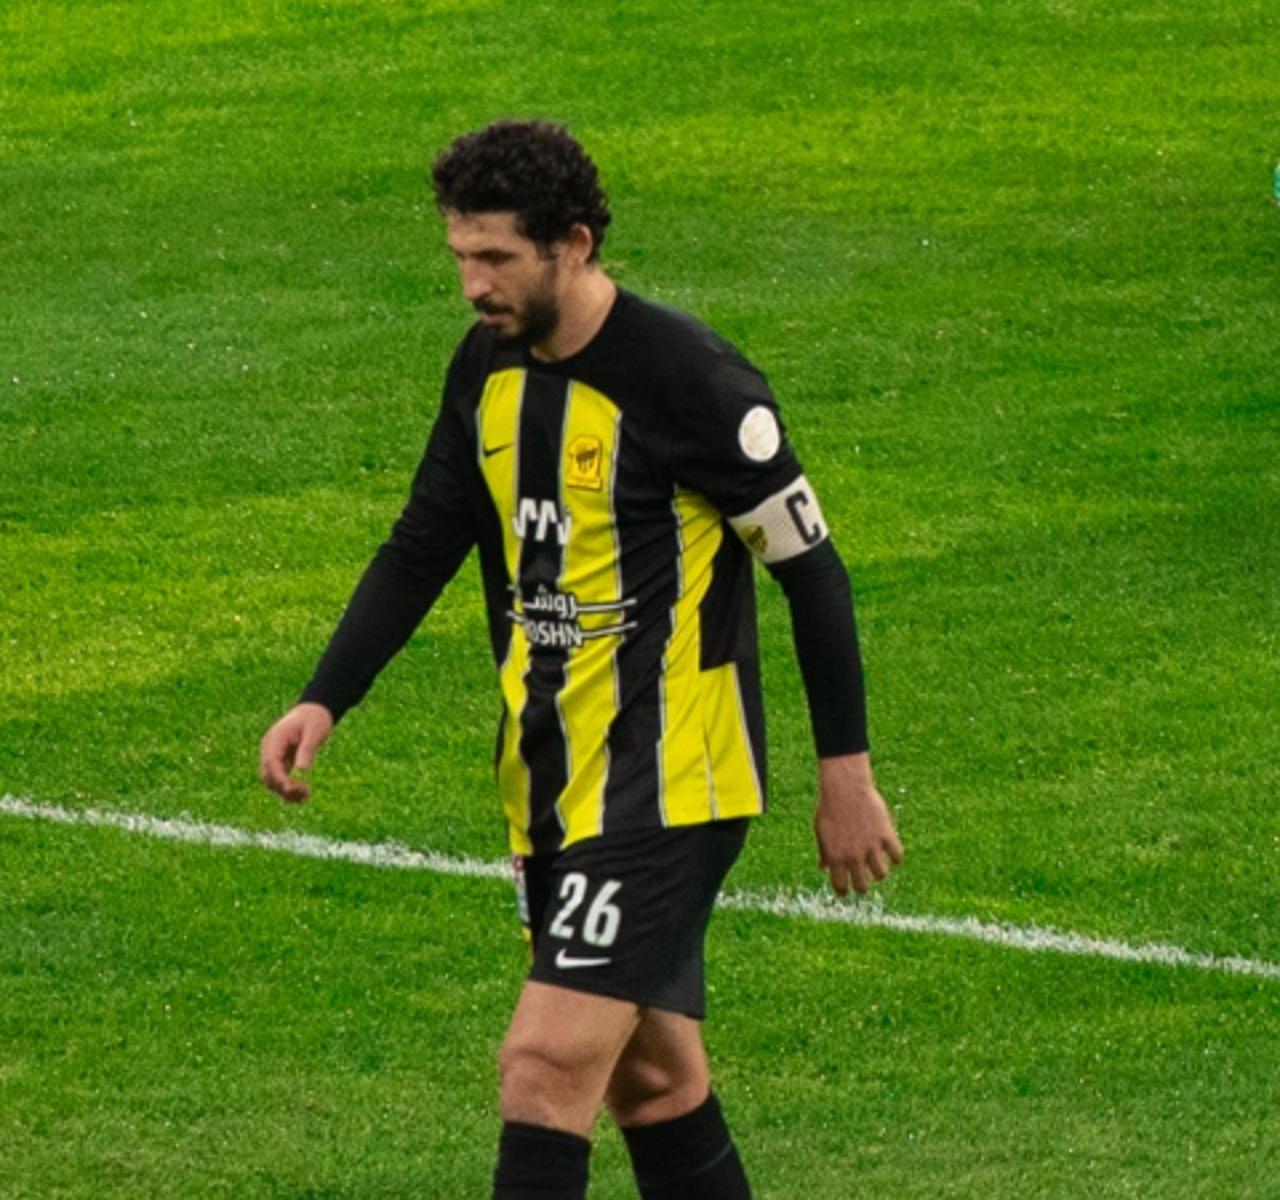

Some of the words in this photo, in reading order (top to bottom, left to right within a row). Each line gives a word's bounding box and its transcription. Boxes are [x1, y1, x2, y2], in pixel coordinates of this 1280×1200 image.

[785, 490, 822, 545] C
[524, 620, 583, 647] OSHN
[548, 871, 623, 947] 26
